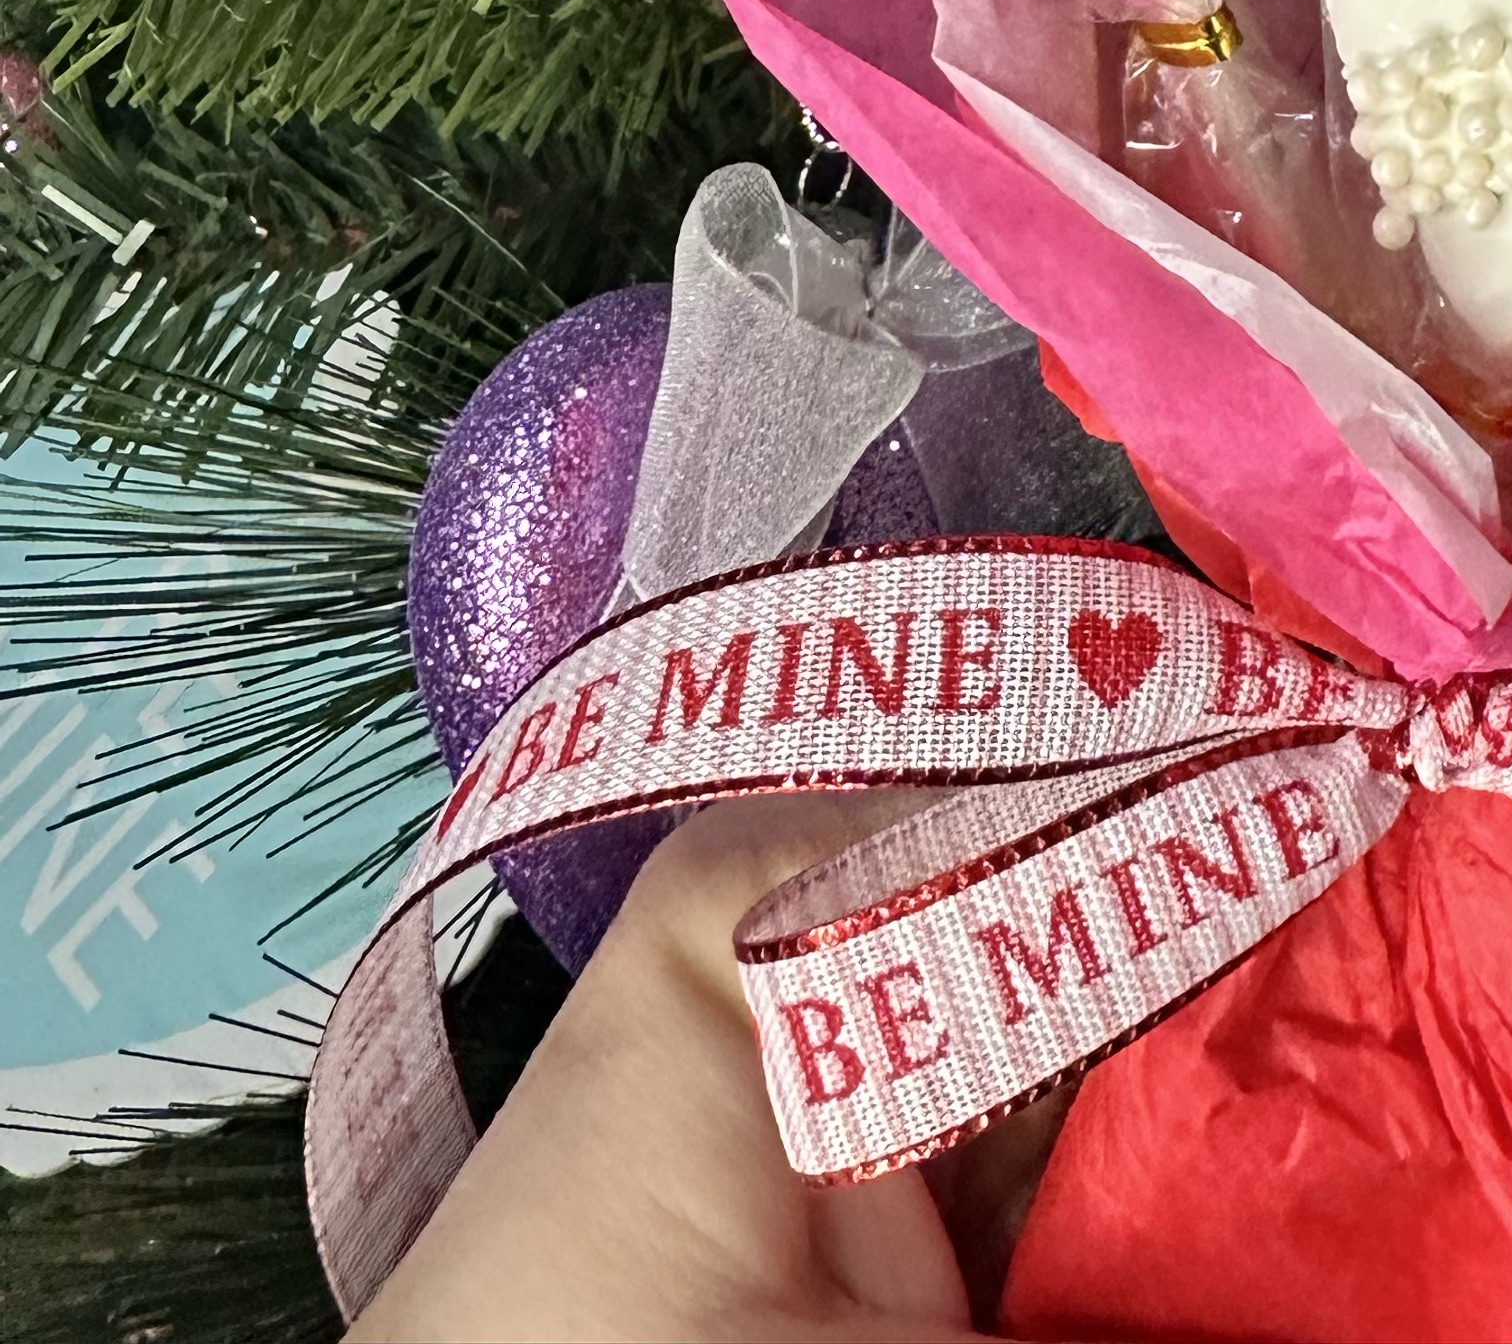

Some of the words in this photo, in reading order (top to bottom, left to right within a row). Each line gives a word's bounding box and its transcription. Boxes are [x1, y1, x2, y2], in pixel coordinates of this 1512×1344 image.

[0, 624, 214, 1013] INE
[482, 671, 621, 808] BE
[644, 608, 999, 746] MINE
[775, 962, 951, 1106] BE
[975, 779, 1342, 1025] MINE
